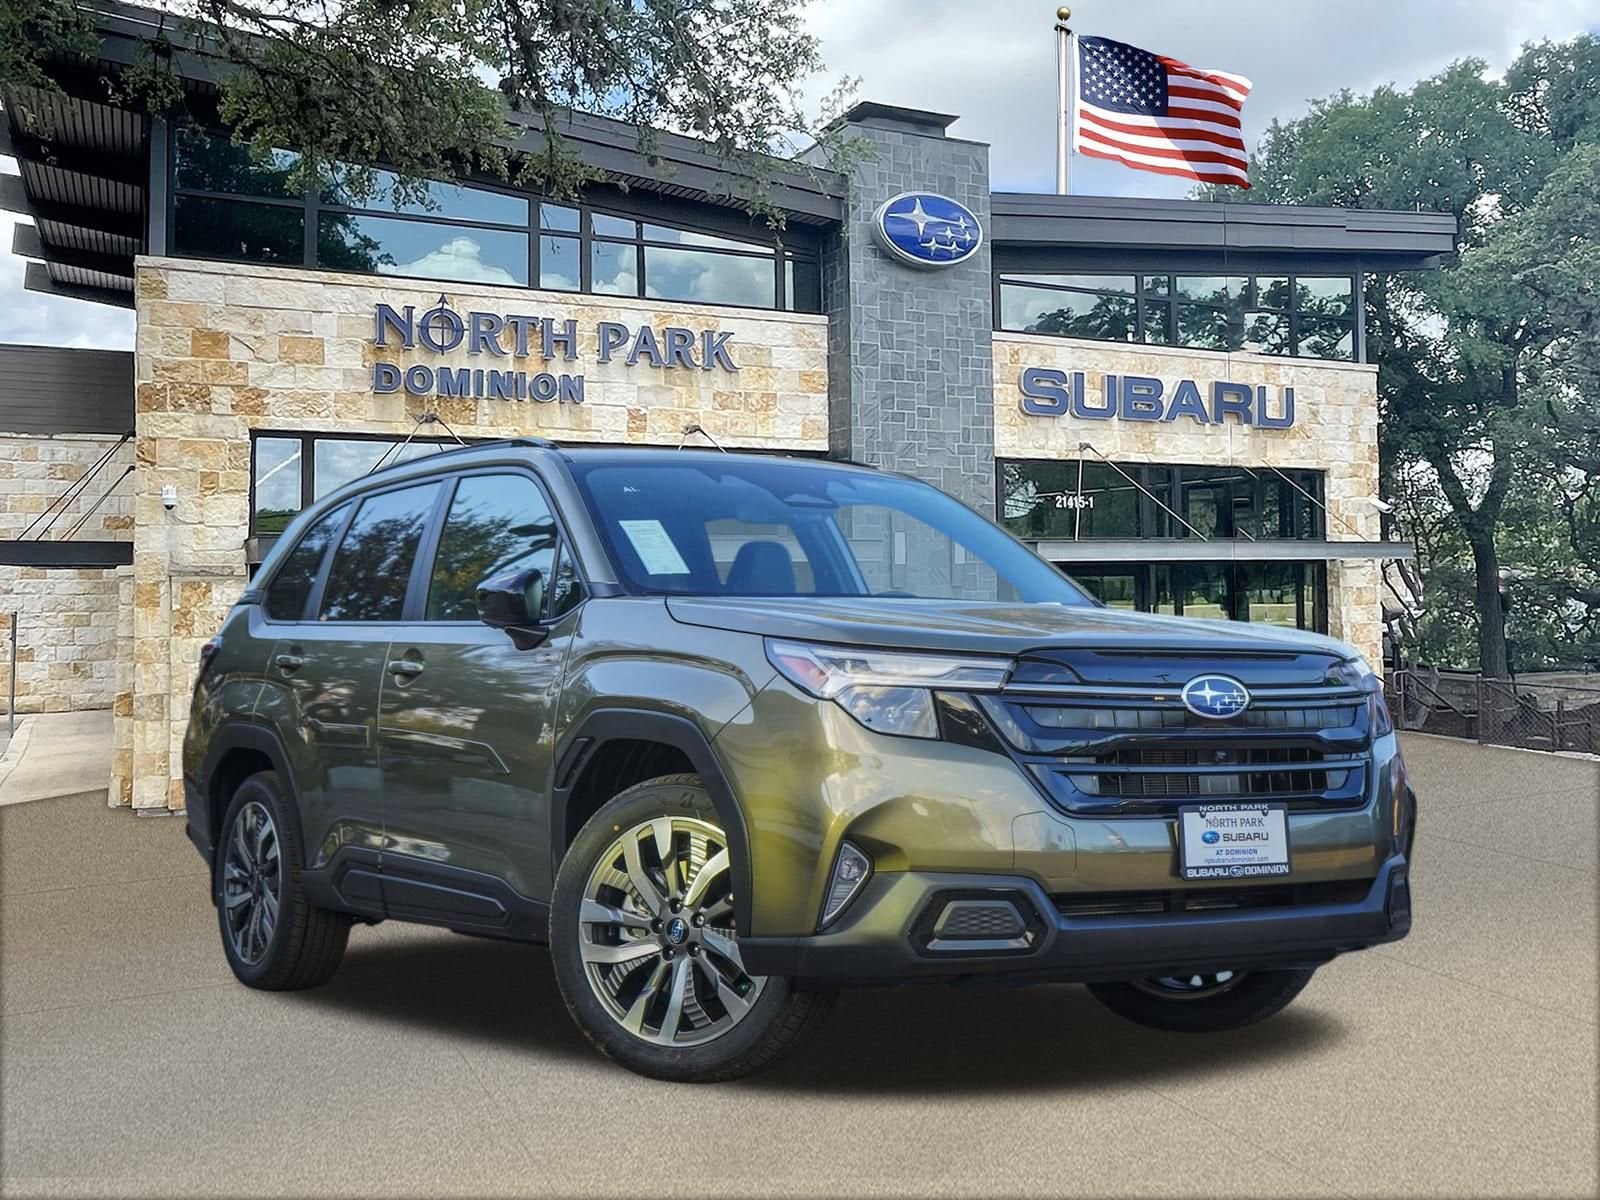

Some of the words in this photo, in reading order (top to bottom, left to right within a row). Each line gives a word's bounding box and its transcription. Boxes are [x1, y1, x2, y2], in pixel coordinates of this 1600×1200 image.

[375, 294, 579, 361] NORTH
[597, 321, 741, 373] PARK
[373, 362, 585, 404] DOMINION
[1019, 367, 1295, 429] SUBARU
[1206, 816, 1237, 828] NORTH
[1240, 817, 1265, 828] PARK
[1222, 832, 1269, 842] SUBARU
[1187, 868, 1229, 877] SUBARU
[1244, 864, 1289, 875] DOMINION
